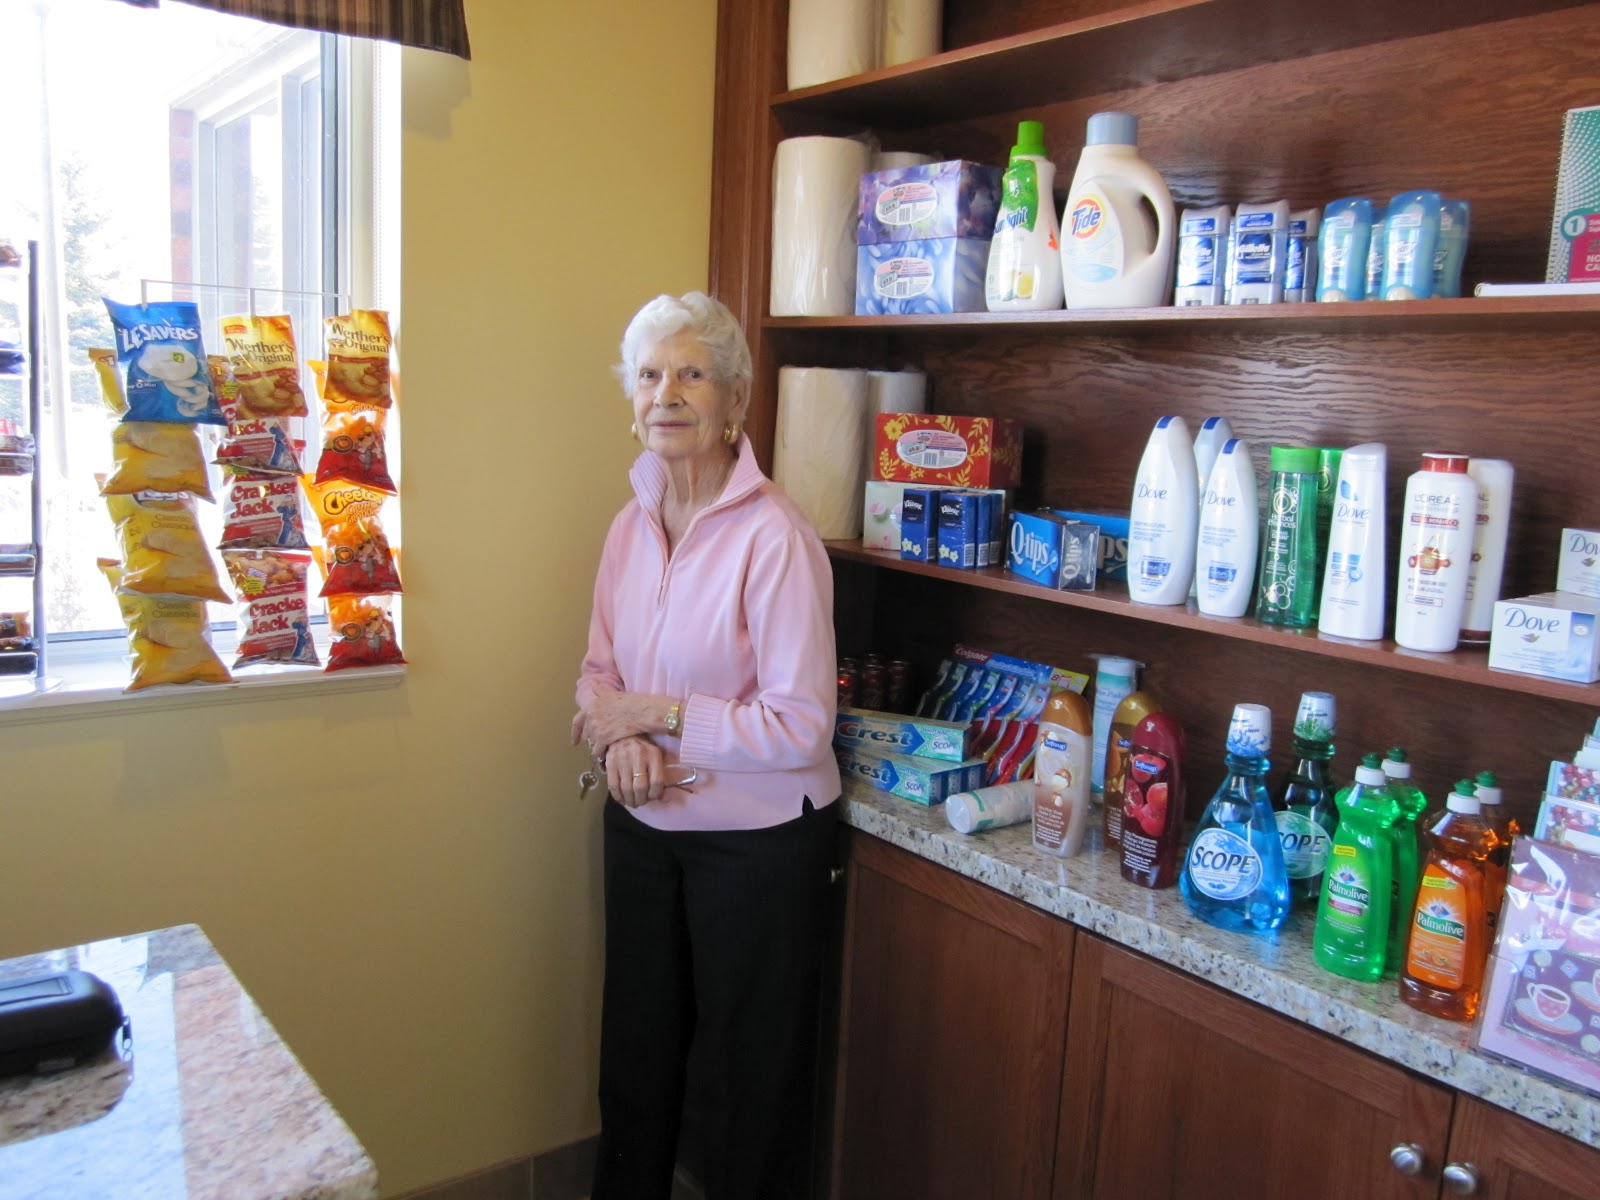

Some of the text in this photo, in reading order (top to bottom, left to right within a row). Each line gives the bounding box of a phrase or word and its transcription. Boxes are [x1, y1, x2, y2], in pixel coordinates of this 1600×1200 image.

[1072, 206, 1102, 236] Tide
[1569, 218, 1579, 233] 1
[1585, 263, 1600, 272] CA
[1586, 254, 1600, 263] NO
[332, 322, 391, 343] Werther's
[225, 337, 295, 354] Werther's
[344, 337, 389, 353] Original
[249, 350, 295, 365] Original
[1137, 483, 1168, 500] Dove
[1207, 491, 1236, 507] Dove
[230, 497, 275, 519] Jack
[1337, 502, 1369, 520] Dove
[1011, 521, 1050, 571] Q-tips
[1570, 533, 1600, 556] Dov
[246, 614, 290, 636] Jack
[1504, 607, 1561, 633] Dove
[955, 647, 988, 661] Colgate
[837, 721, 914, 748] Crest
[1191, 846, 1256, 875] SCOPE
[1328, 879, 1369, 902] Palmolive
[1417, 912, 1464, 937] Palmolive
